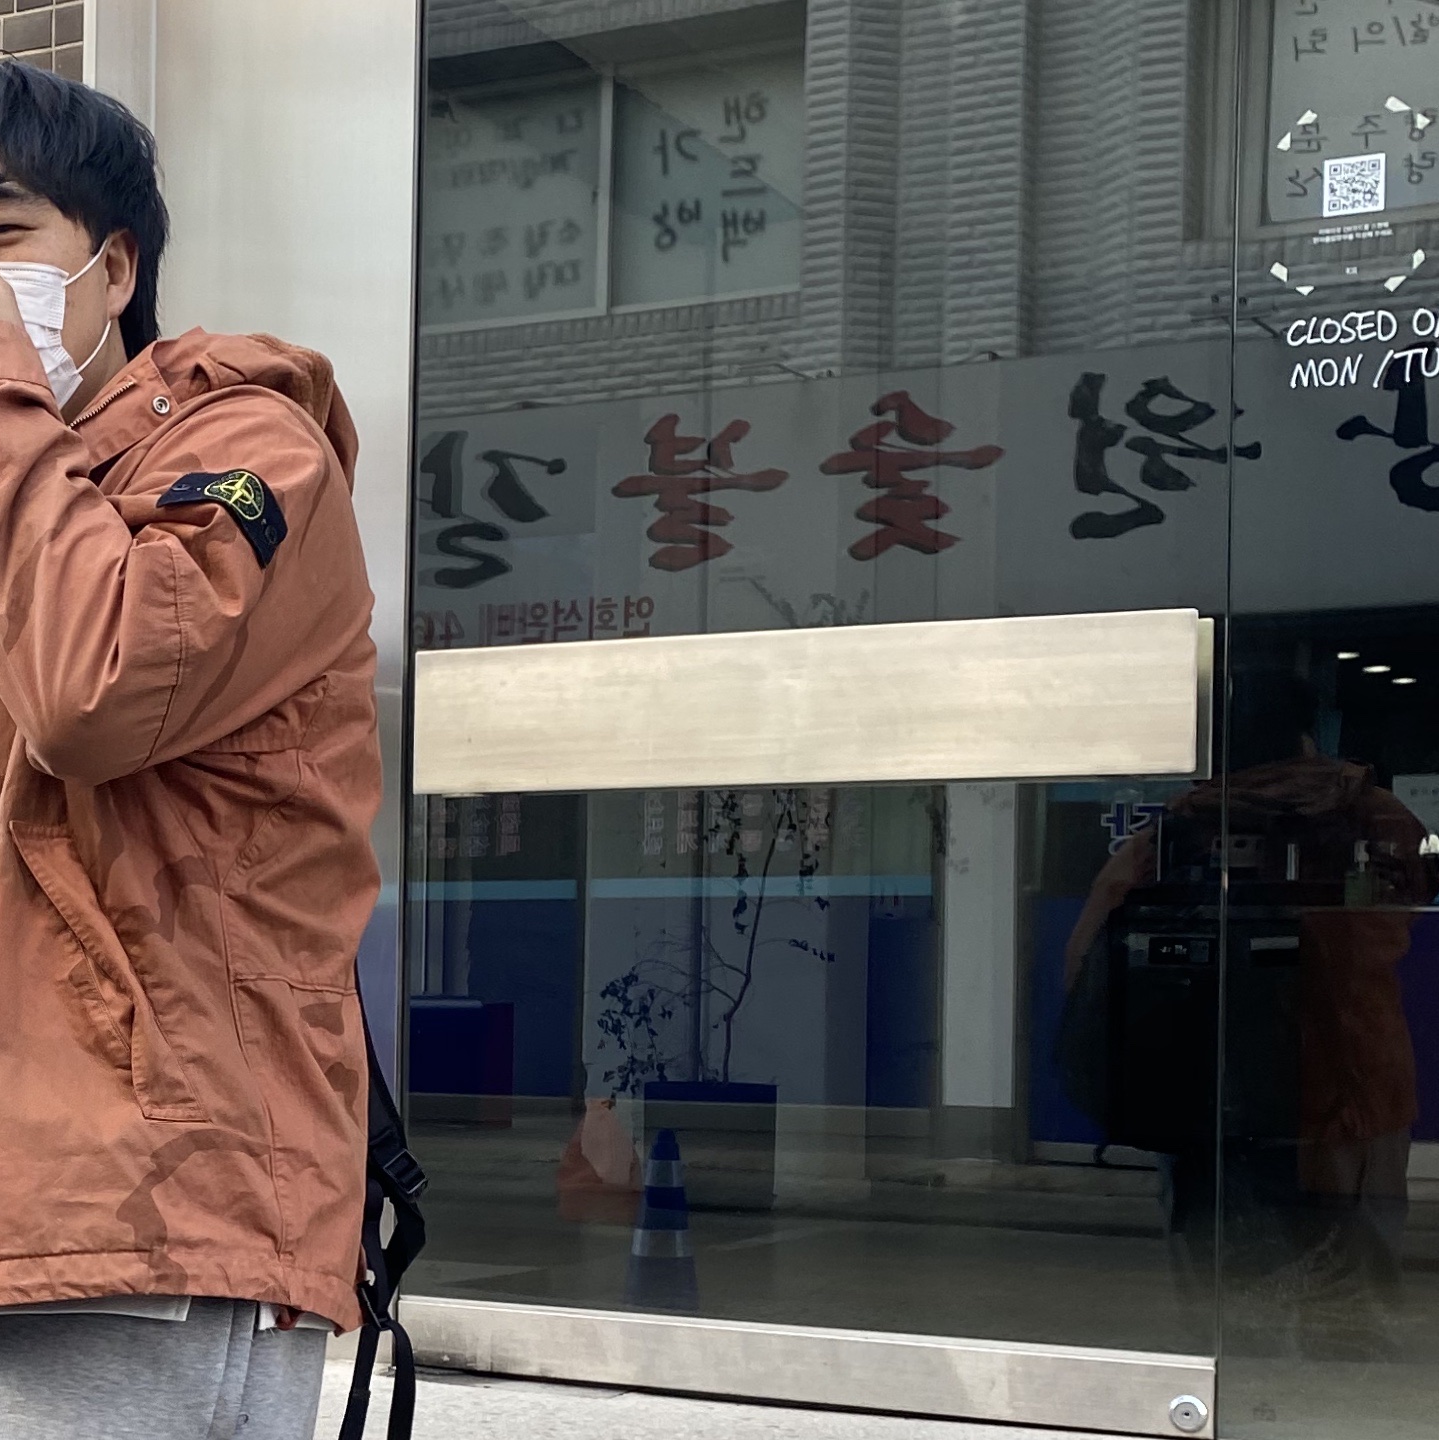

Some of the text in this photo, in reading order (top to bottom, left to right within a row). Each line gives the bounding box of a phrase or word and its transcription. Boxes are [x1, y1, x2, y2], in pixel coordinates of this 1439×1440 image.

[1287, 308, 1439, 347] CLOSED O
[1290, 353, 1363, 389] MON
